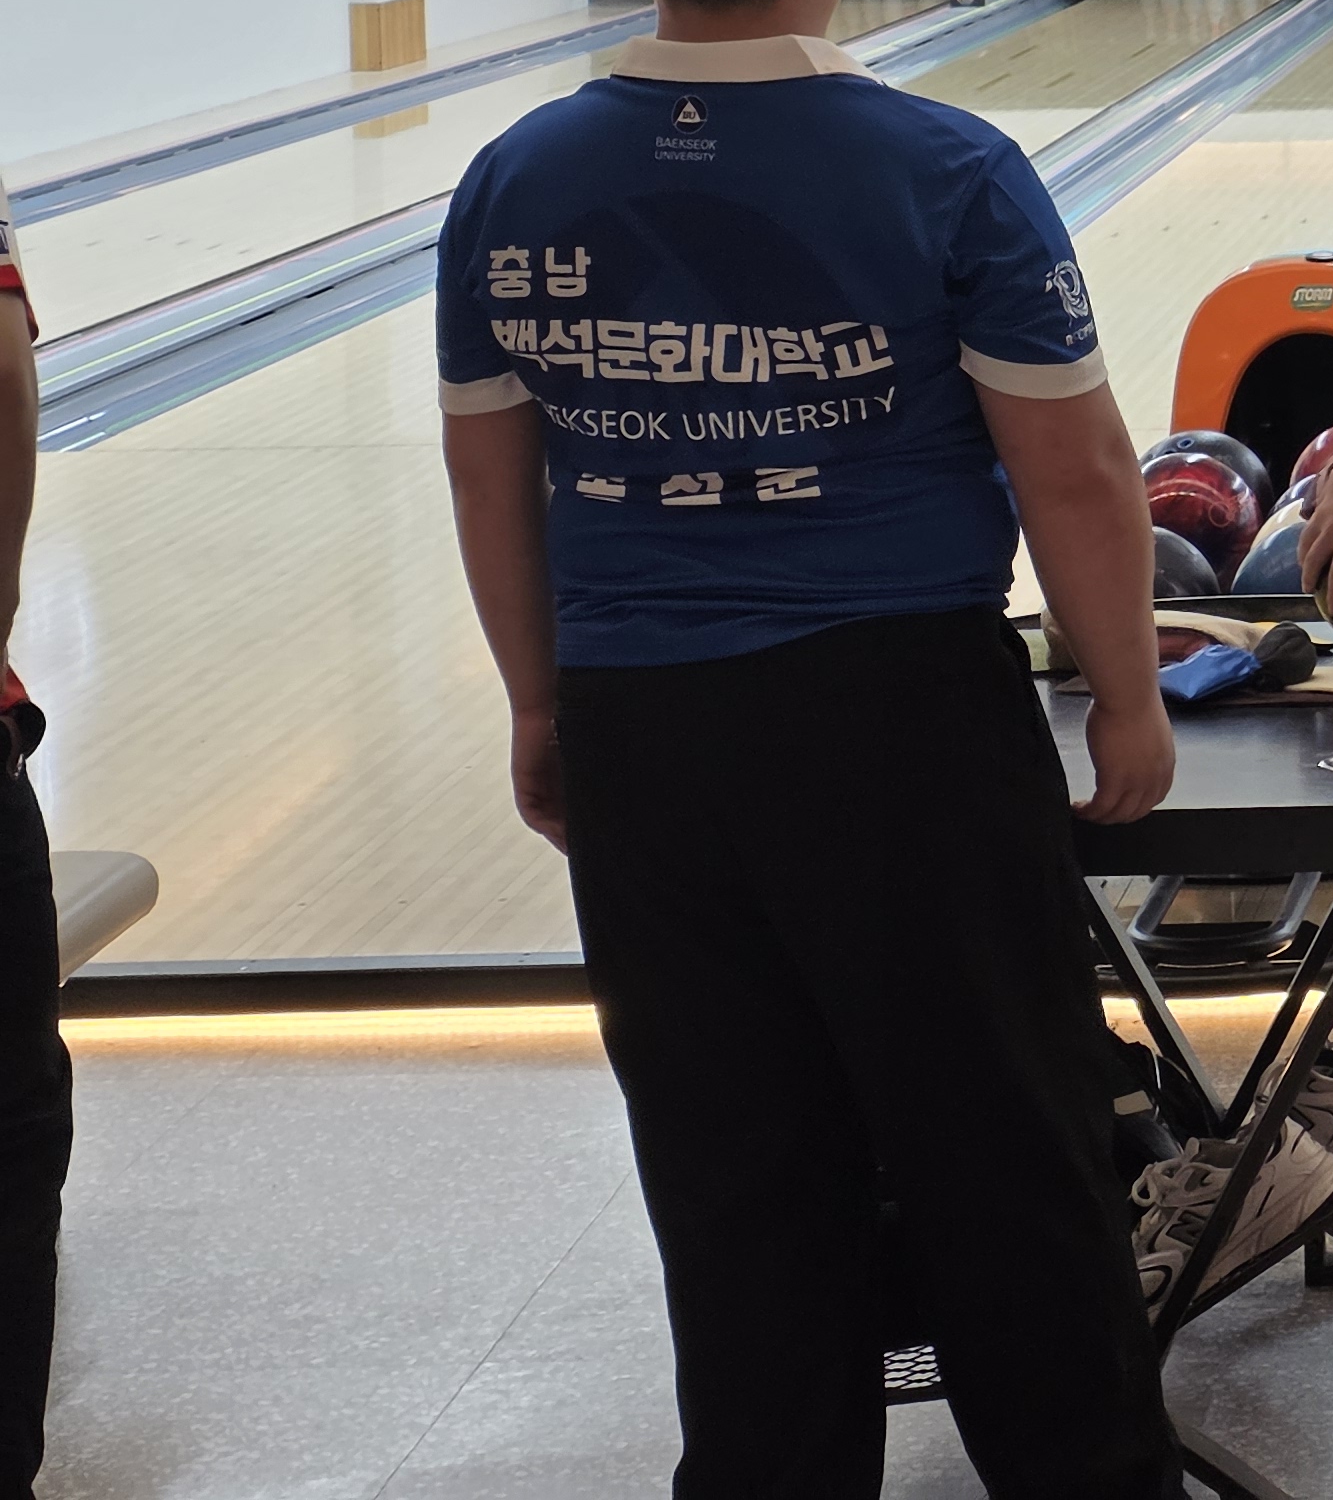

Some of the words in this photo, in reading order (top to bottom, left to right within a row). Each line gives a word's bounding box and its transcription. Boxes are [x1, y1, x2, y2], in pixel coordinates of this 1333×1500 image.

[653, 149, 717, 164] UNIVERSITY
[654, 135, 718, 152] BAEKSEOK
[490, 318, 896, 385] 백석문화대학교
[681, 385, 898, 442] UNIVERSITY
